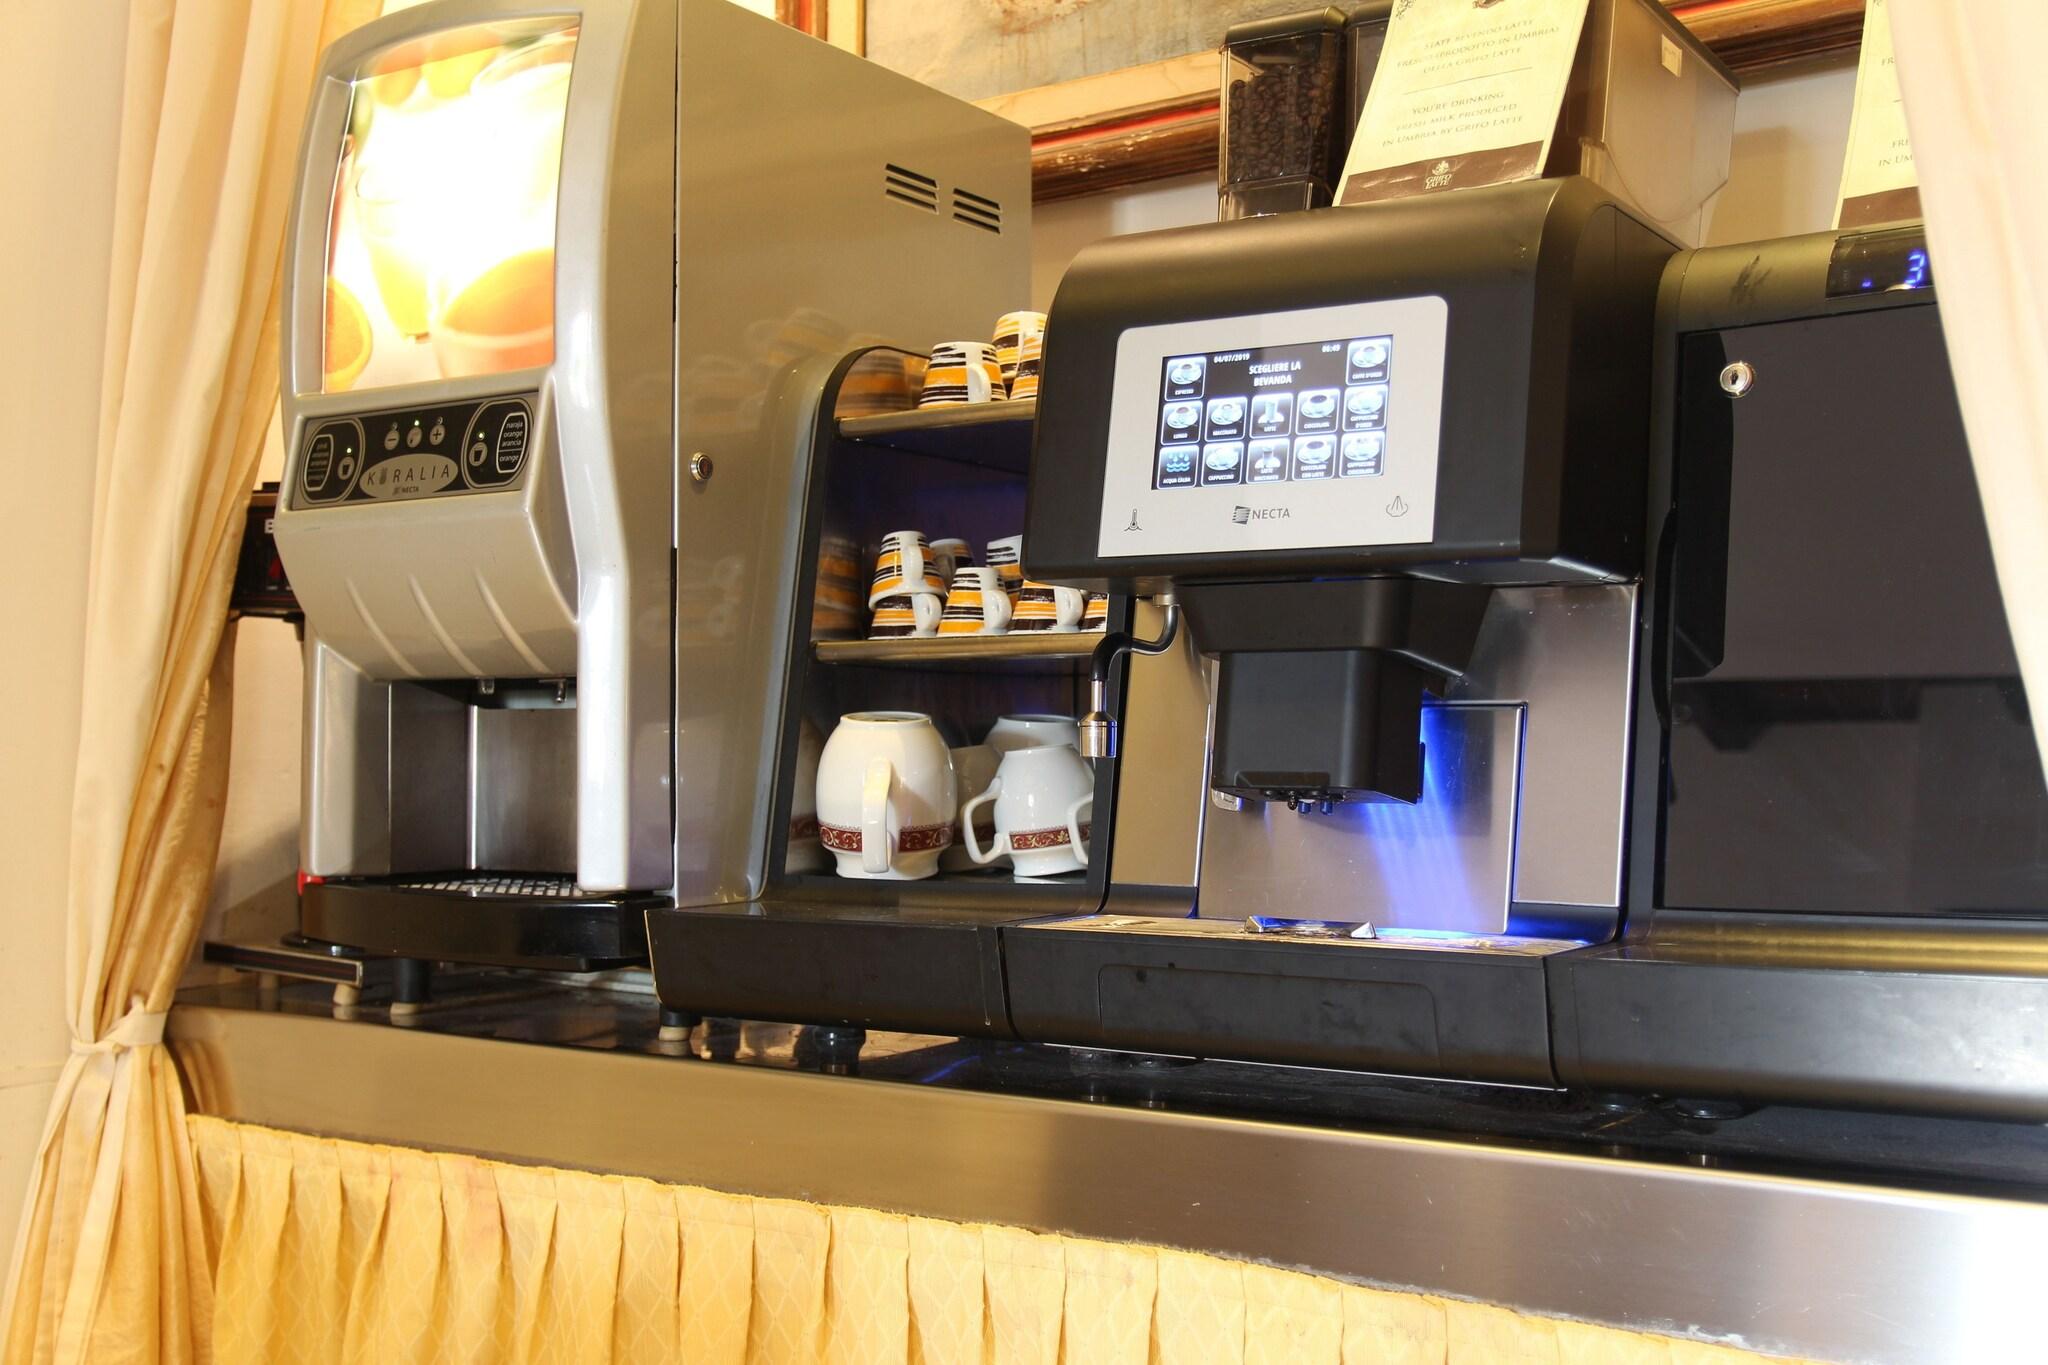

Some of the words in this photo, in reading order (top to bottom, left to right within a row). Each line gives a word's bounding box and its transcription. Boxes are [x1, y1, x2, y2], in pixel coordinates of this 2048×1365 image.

[1492, 47, 1521, 58] LATTE
[1412, 102, 1447, 115] YOU'RE
[1450, 92, 1504, 107] DRINKING
[1430, 115, 1454, 124] MILK
[1458, 103, 1518, 118] PRODUCED
[1397, 131, 1436, 144] UMBRIA
[1440, 127, 1452, 135] BY
[1455, 120, 1489, 133] GRIFO
[1492, 115, 1523, 127] LATTE
[1879, 159, 1891, 167] IN
[1425, 180, 1449, 190] LATTE
[1249, 362, 1289, 375] SCEGLIERE
[1290, 361, 1302, 371] LA
[1253, 375, 1293, 387] BEVANDA
[1252, 508, 1290, 519] NECTA
